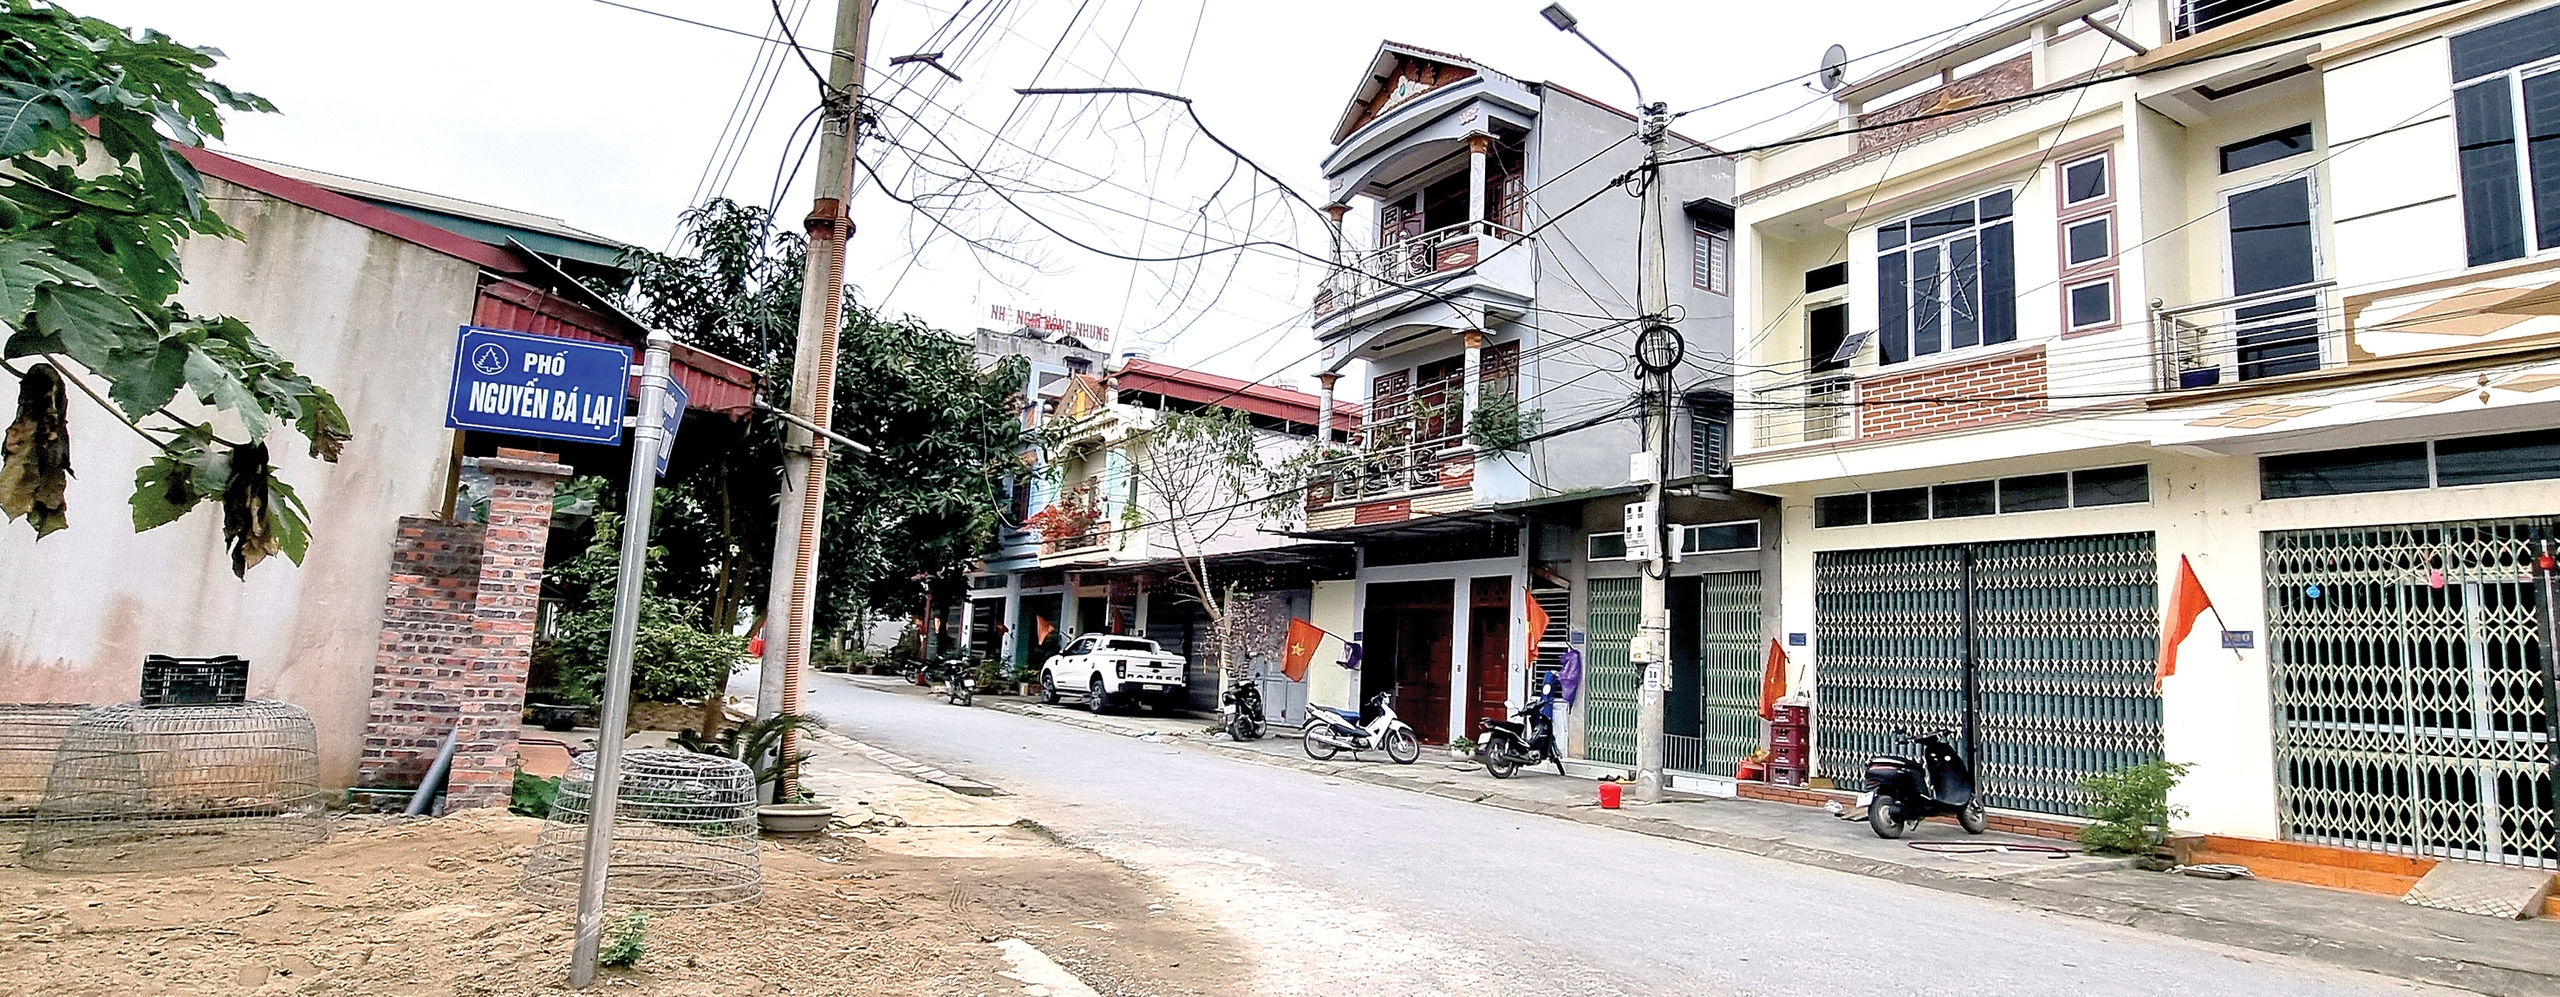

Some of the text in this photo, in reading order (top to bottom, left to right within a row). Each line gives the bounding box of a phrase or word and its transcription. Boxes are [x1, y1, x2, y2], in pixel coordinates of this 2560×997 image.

[1075, 321, 1110, 343] NHUNG
[523, 350, 569, 376] PHỐ
[469, 377, 613, 431] NGUYỄN BÁ LẠI
[1127, 673, 1182, 681] RANGER
